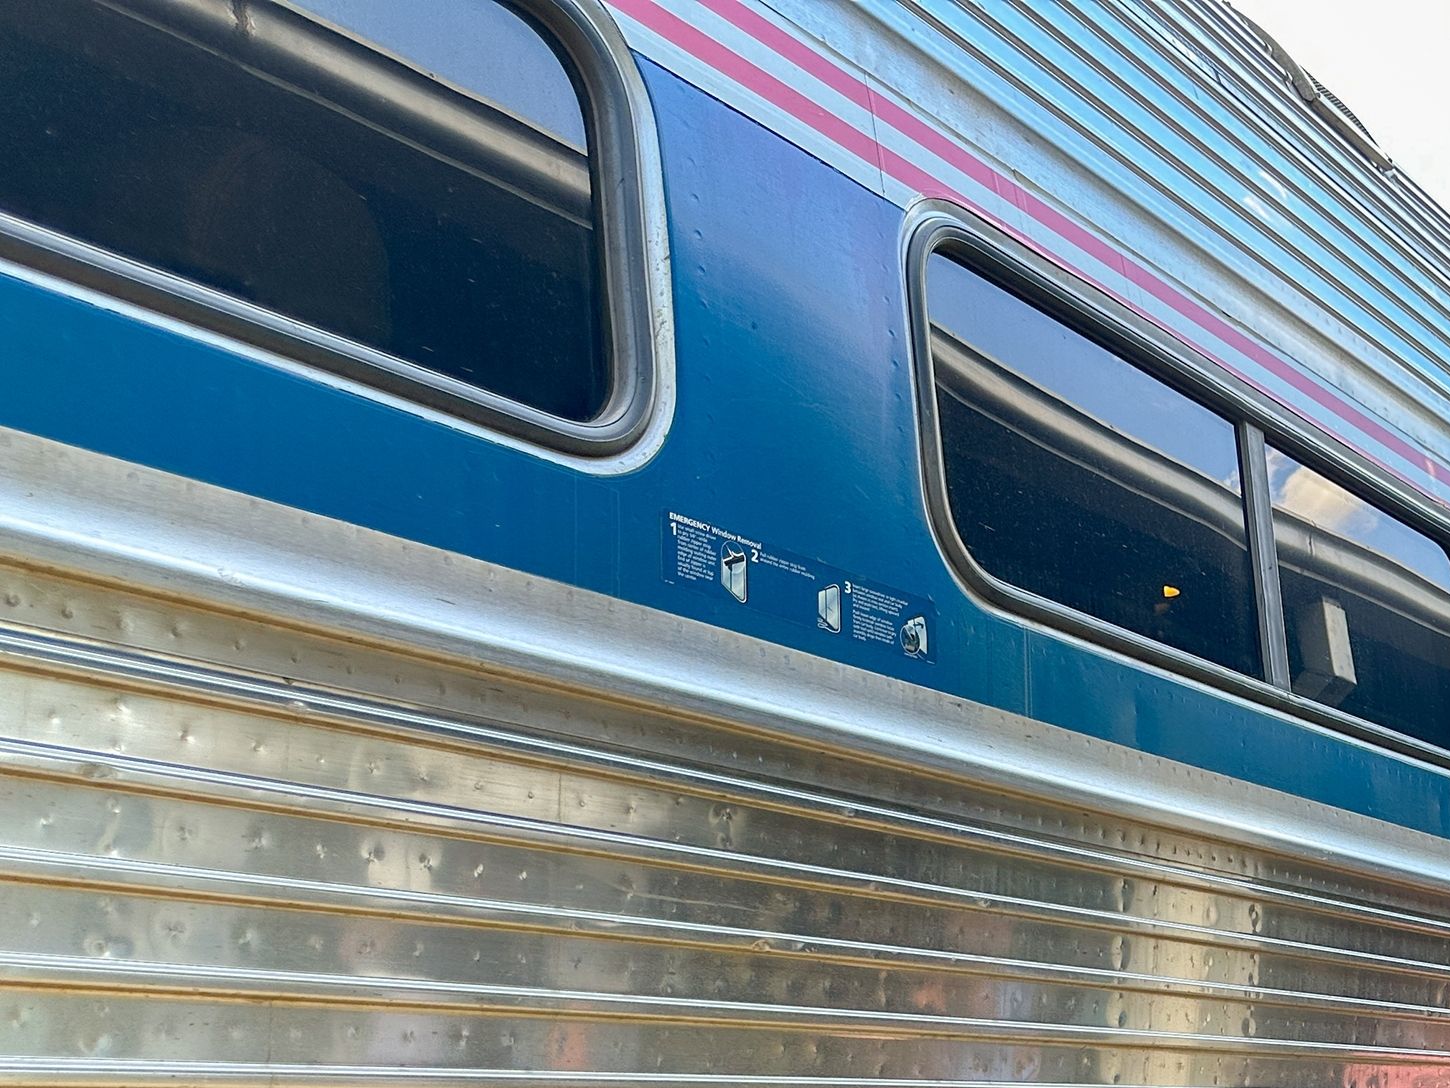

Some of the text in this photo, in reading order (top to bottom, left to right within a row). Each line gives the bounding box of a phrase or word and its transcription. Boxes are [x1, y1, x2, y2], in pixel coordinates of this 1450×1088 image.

[669, 511, 762, 550] EMERGENCY Window Removal
[670, 522, 677, 536] 1
[751, 549, 759, 563] 2
[844, 580, 852, 594] 3
